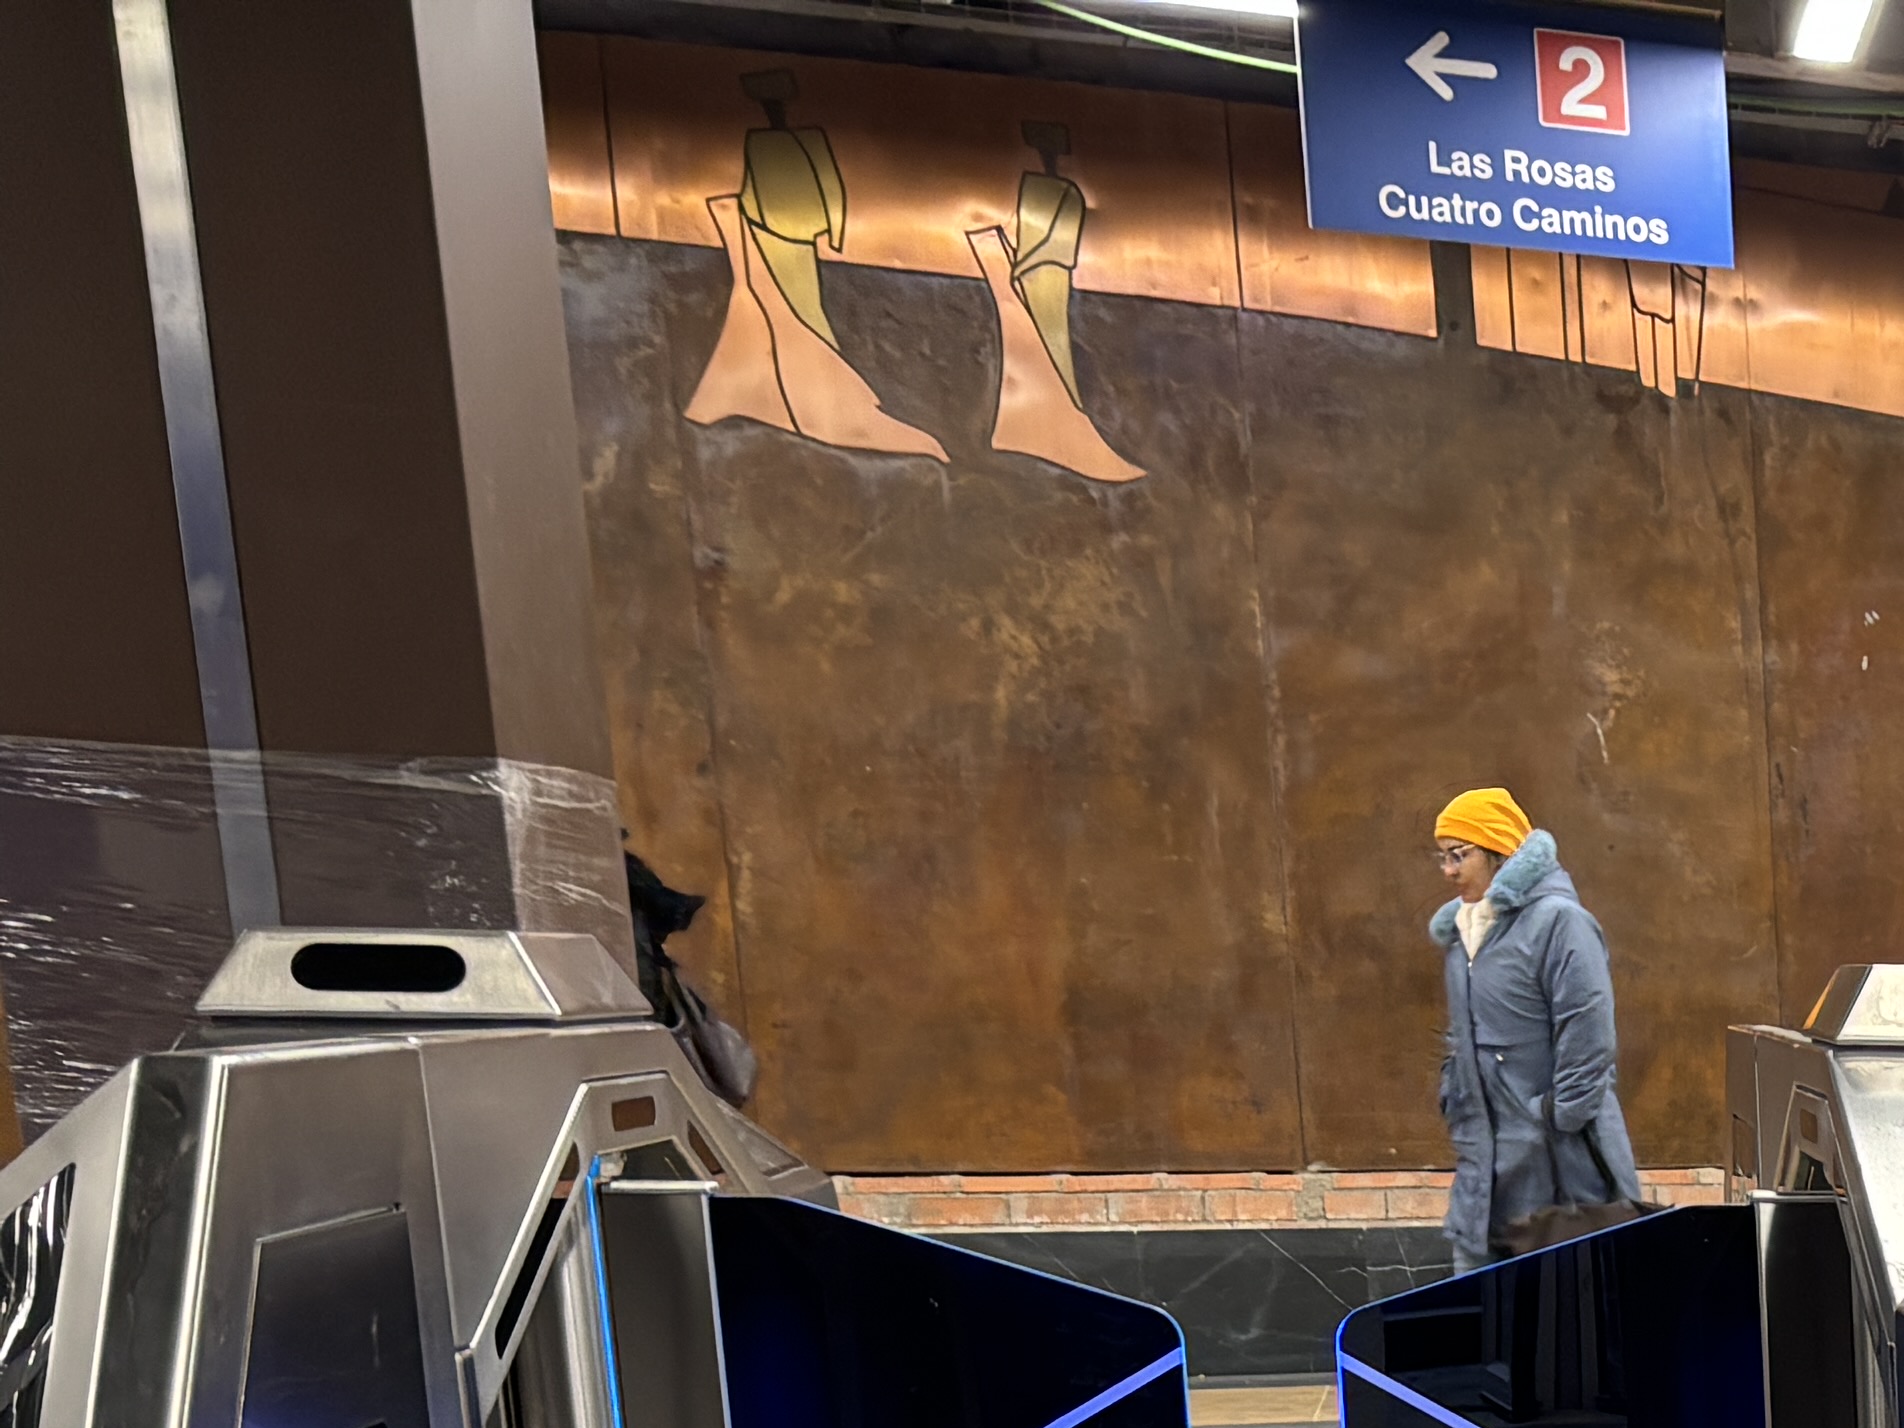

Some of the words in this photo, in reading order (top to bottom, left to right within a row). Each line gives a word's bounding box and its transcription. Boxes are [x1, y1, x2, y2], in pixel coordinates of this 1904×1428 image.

[1558, 46, 1608, 120] 2
[1428, 141, 1492, 180] Las
[1503, 149, 1616, 192] Rosas
[1378, 184, 1502, 228] Cuatro
[1512, 198, 1670, 245] Caminos
